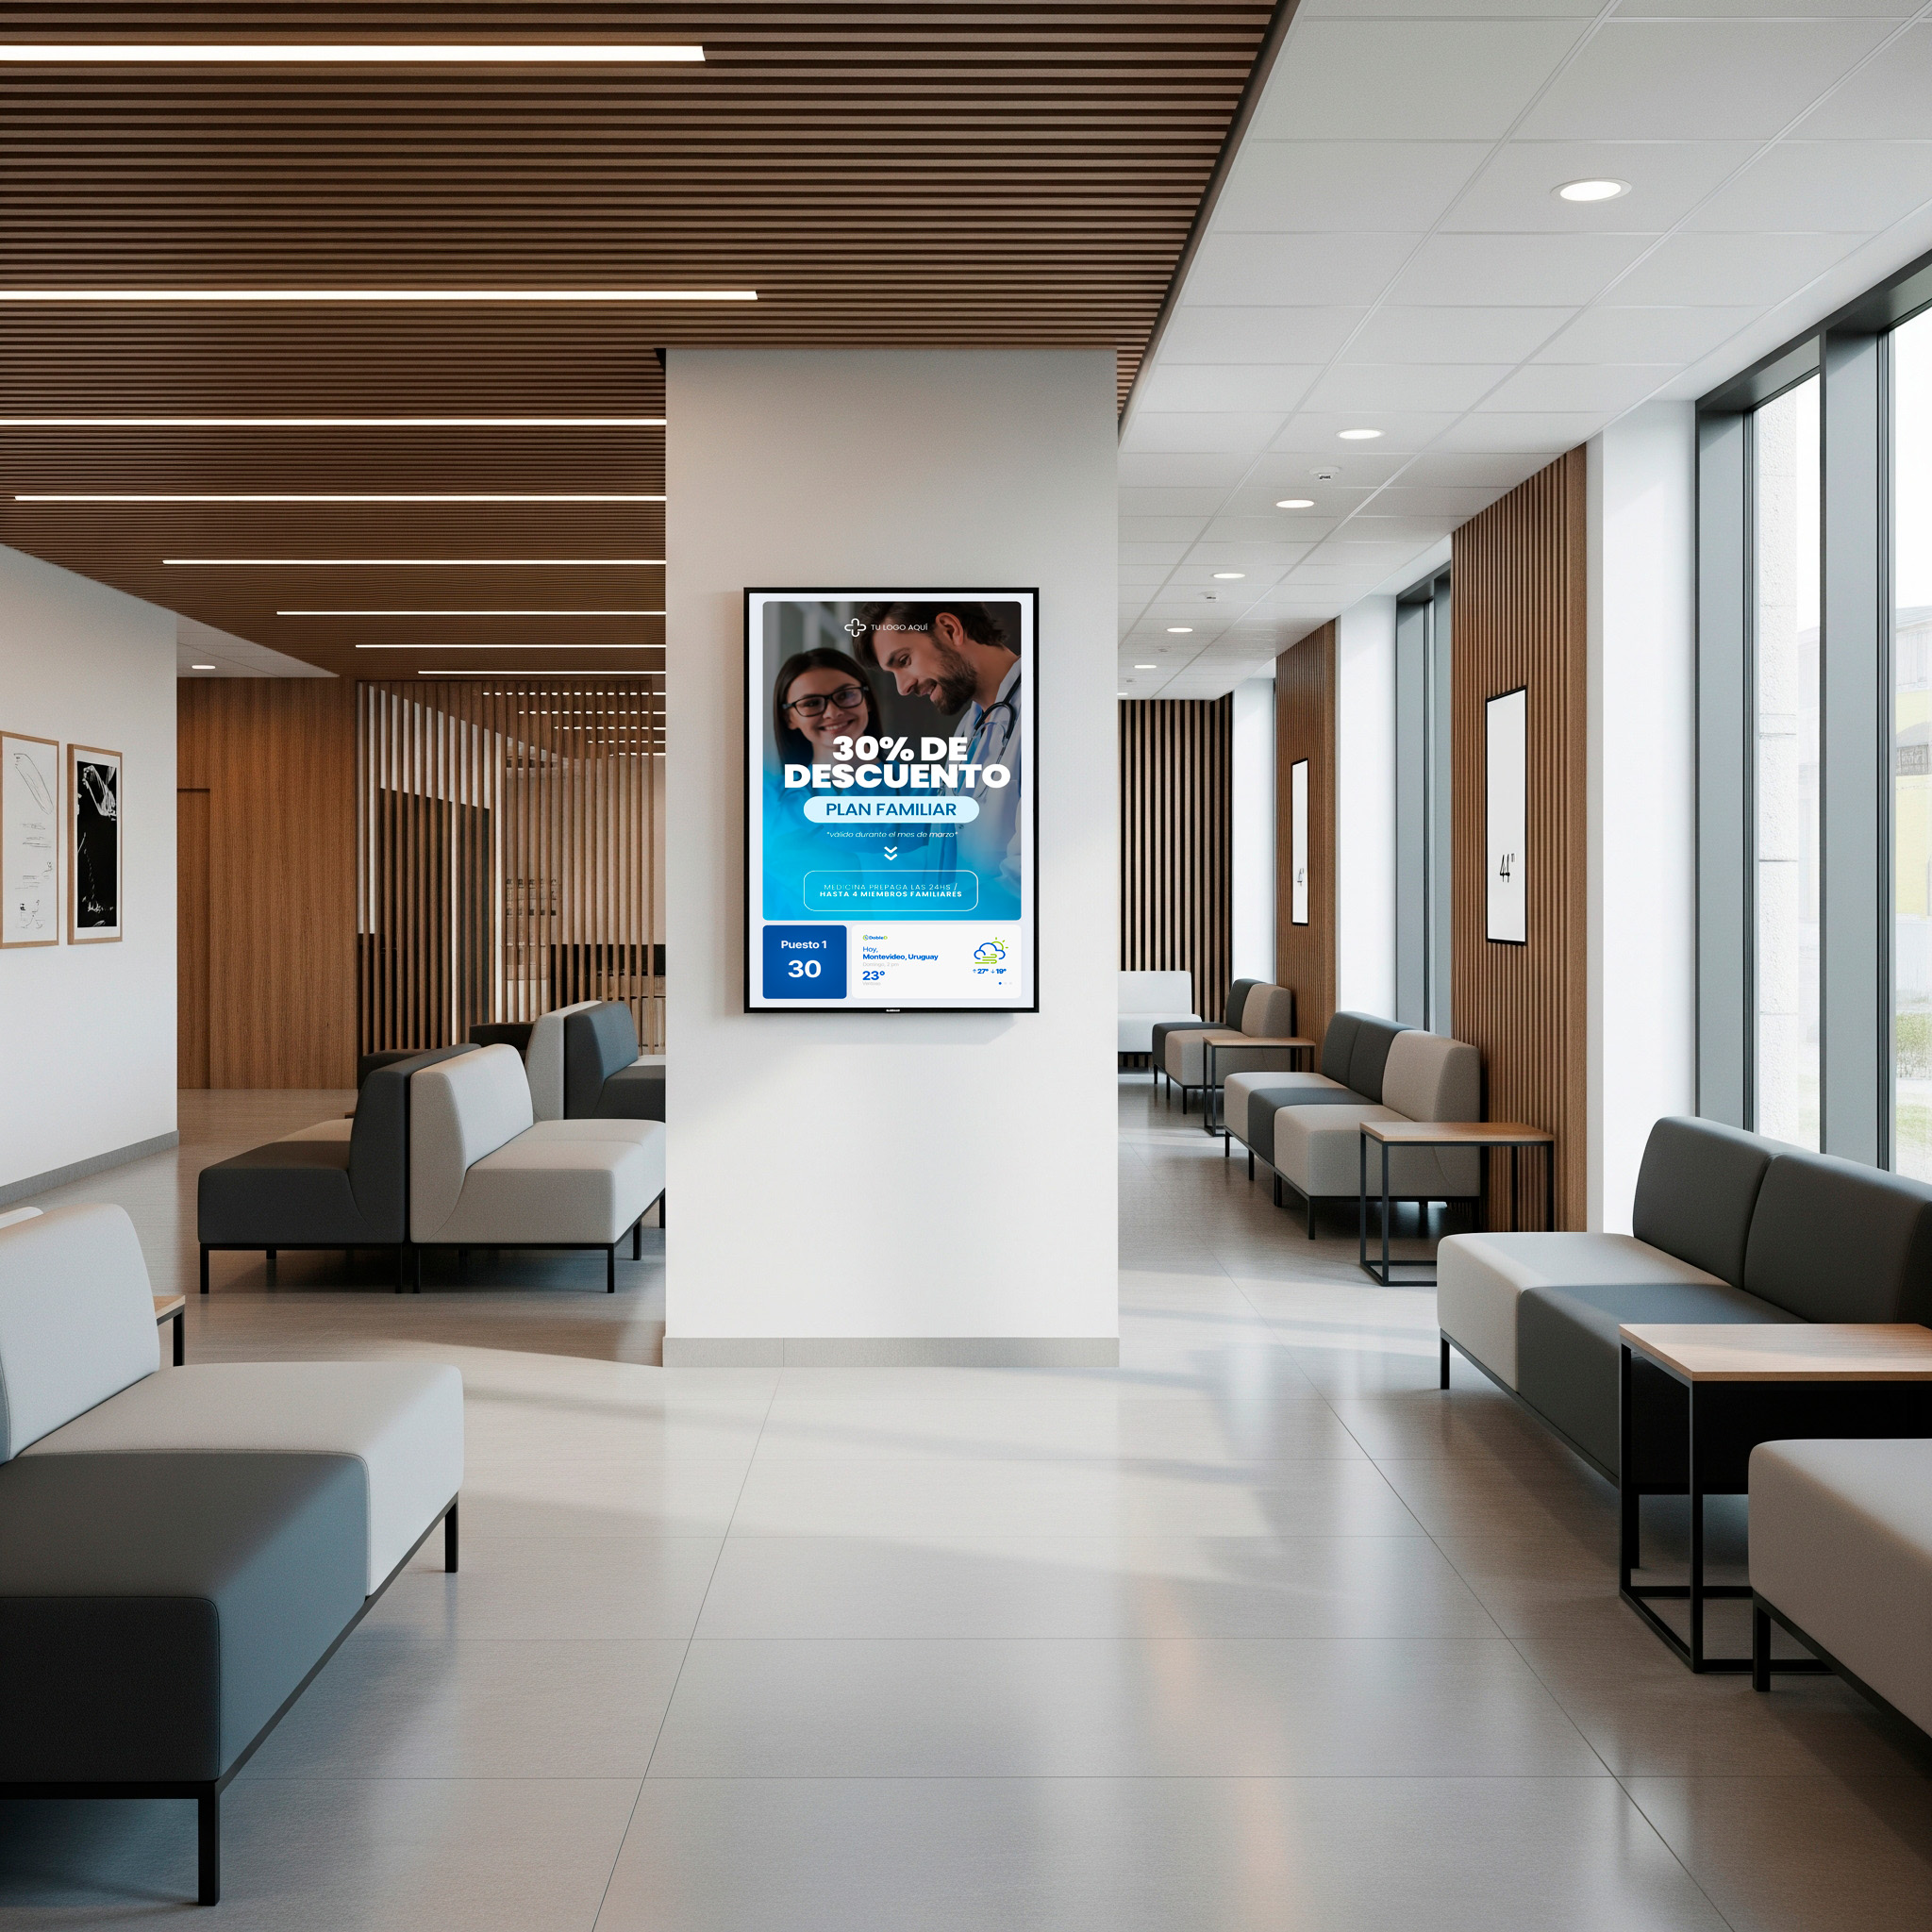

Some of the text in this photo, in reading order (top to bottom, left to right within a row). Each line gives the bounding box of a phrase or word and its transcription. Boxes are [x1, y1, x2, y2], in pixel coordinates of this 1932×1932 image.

[908, 623, 928, 631] AQUÍ
[833, 736, 968, 761] 30% DE
[784, 763, 1011, 789] DESCUENTO
[825, 803, 957, 816] PLAN FAMILIAR
[781, 941, 827, 949] Puesto 1
[788, 959, 822, 978] 30
[862, 971, 885, 981] 23°
